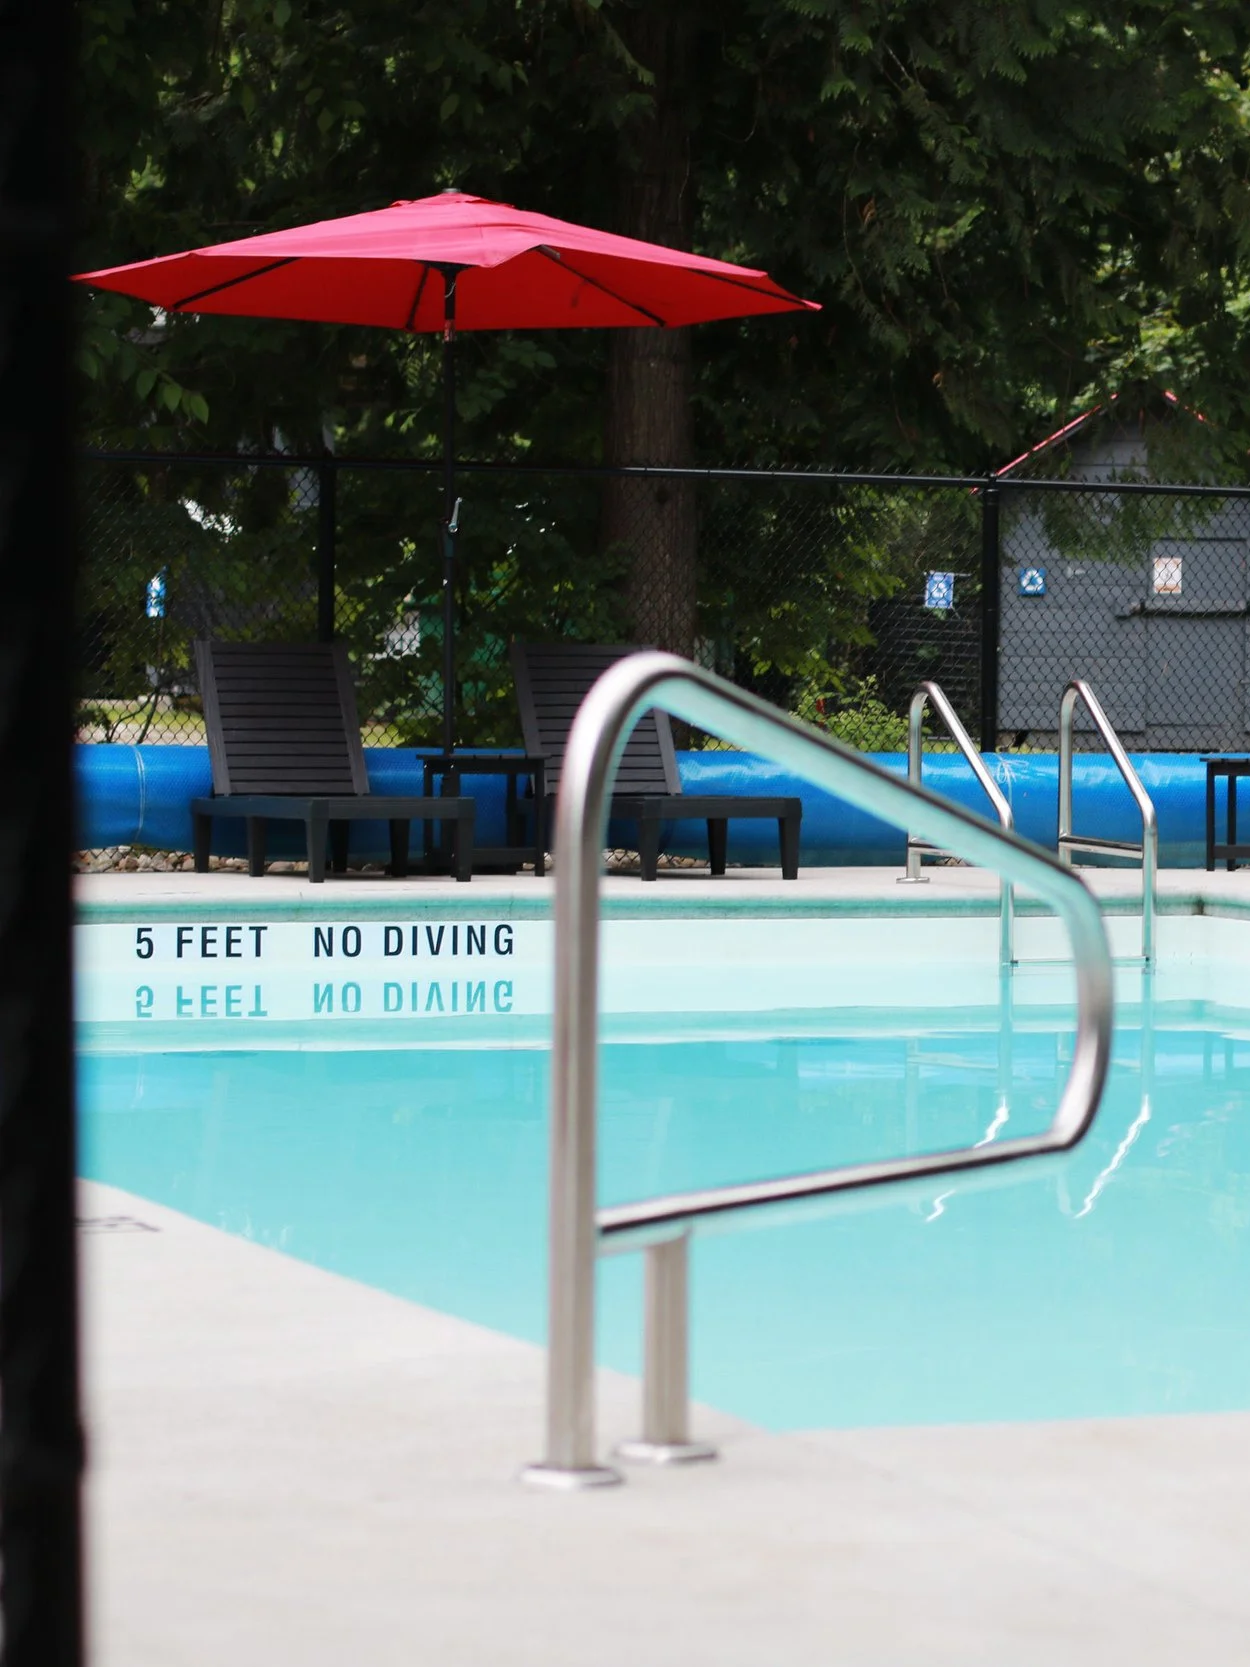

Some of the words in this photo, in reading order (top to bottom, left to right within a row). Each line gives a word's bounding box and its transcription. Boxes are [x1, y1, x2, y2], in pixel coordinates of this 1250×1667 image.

[136, 927, 154, 960] 5
[176, 925, 268, 959] FEET
[314, 925, 362, 958] NO
[383, 923, 513, 957] DIVING
